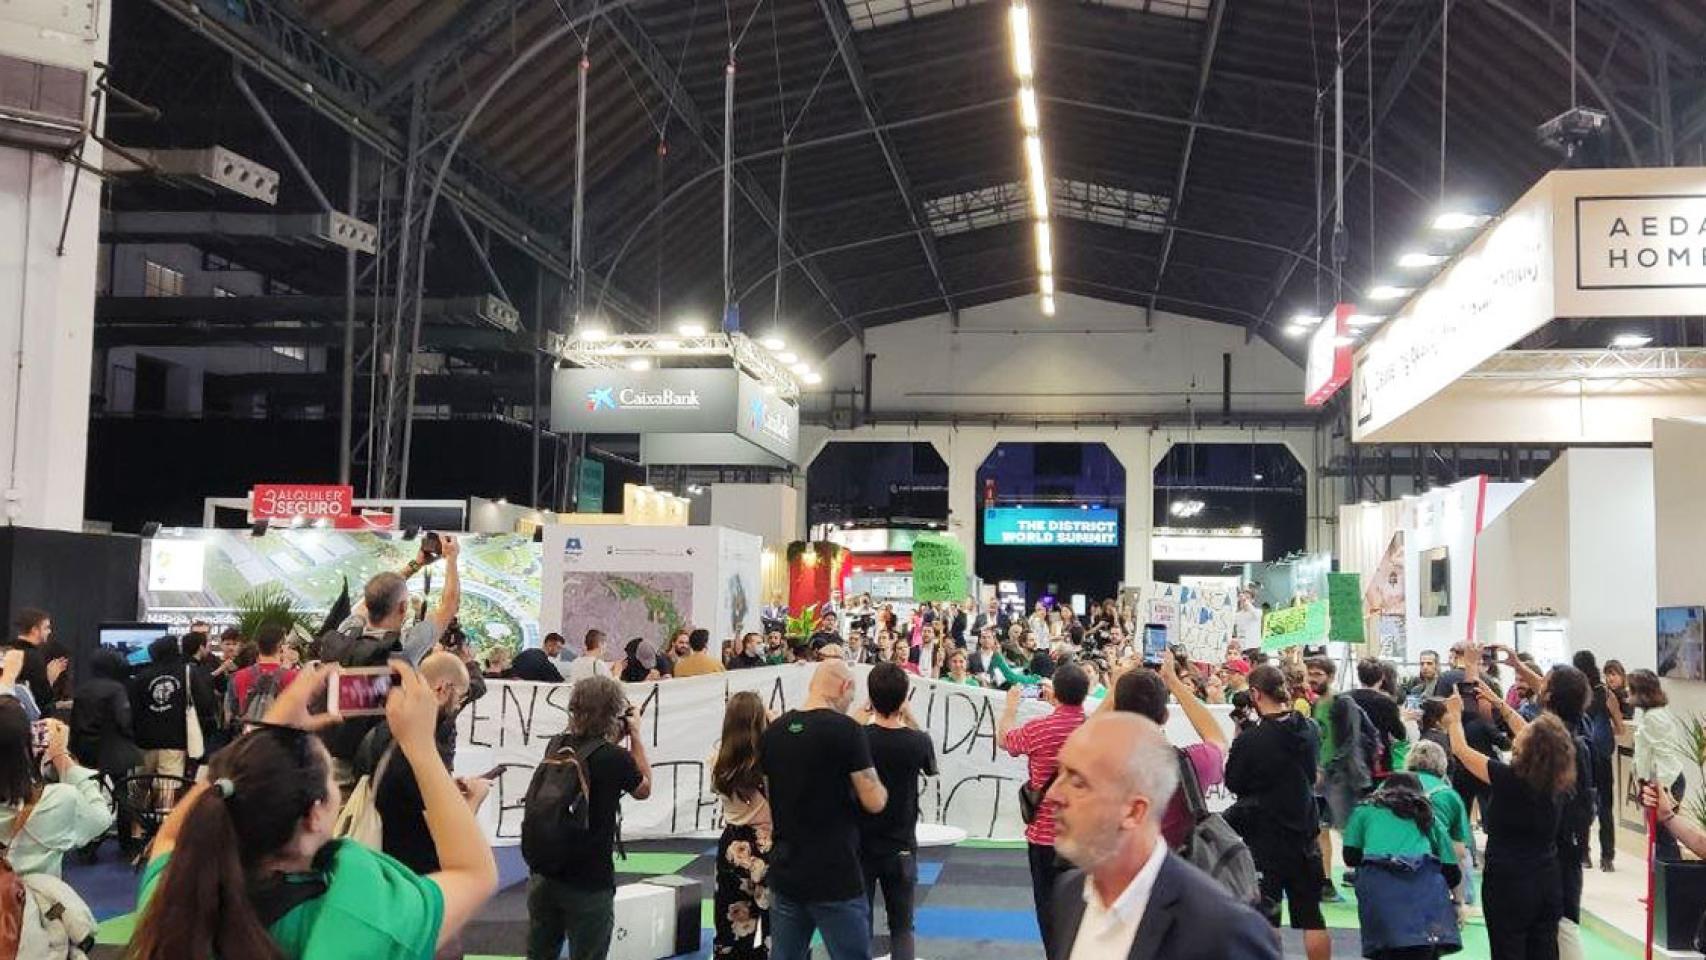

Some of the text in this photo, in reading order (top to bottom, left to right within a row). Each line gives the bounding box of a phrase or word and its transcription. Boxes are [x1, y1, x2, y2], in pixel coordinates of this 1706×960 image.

[1608, 248, 1706, 268] HOM
[620, 387, 700, 405] CaixaBank
[277, 488, 343, 501] ALQUILER
[277, 501, 343, 515] SEGURO
[1017, 520, 1116, 531] THE DISTRICT
[1002, 532, 1115, 543] WORLD SUMMIT
